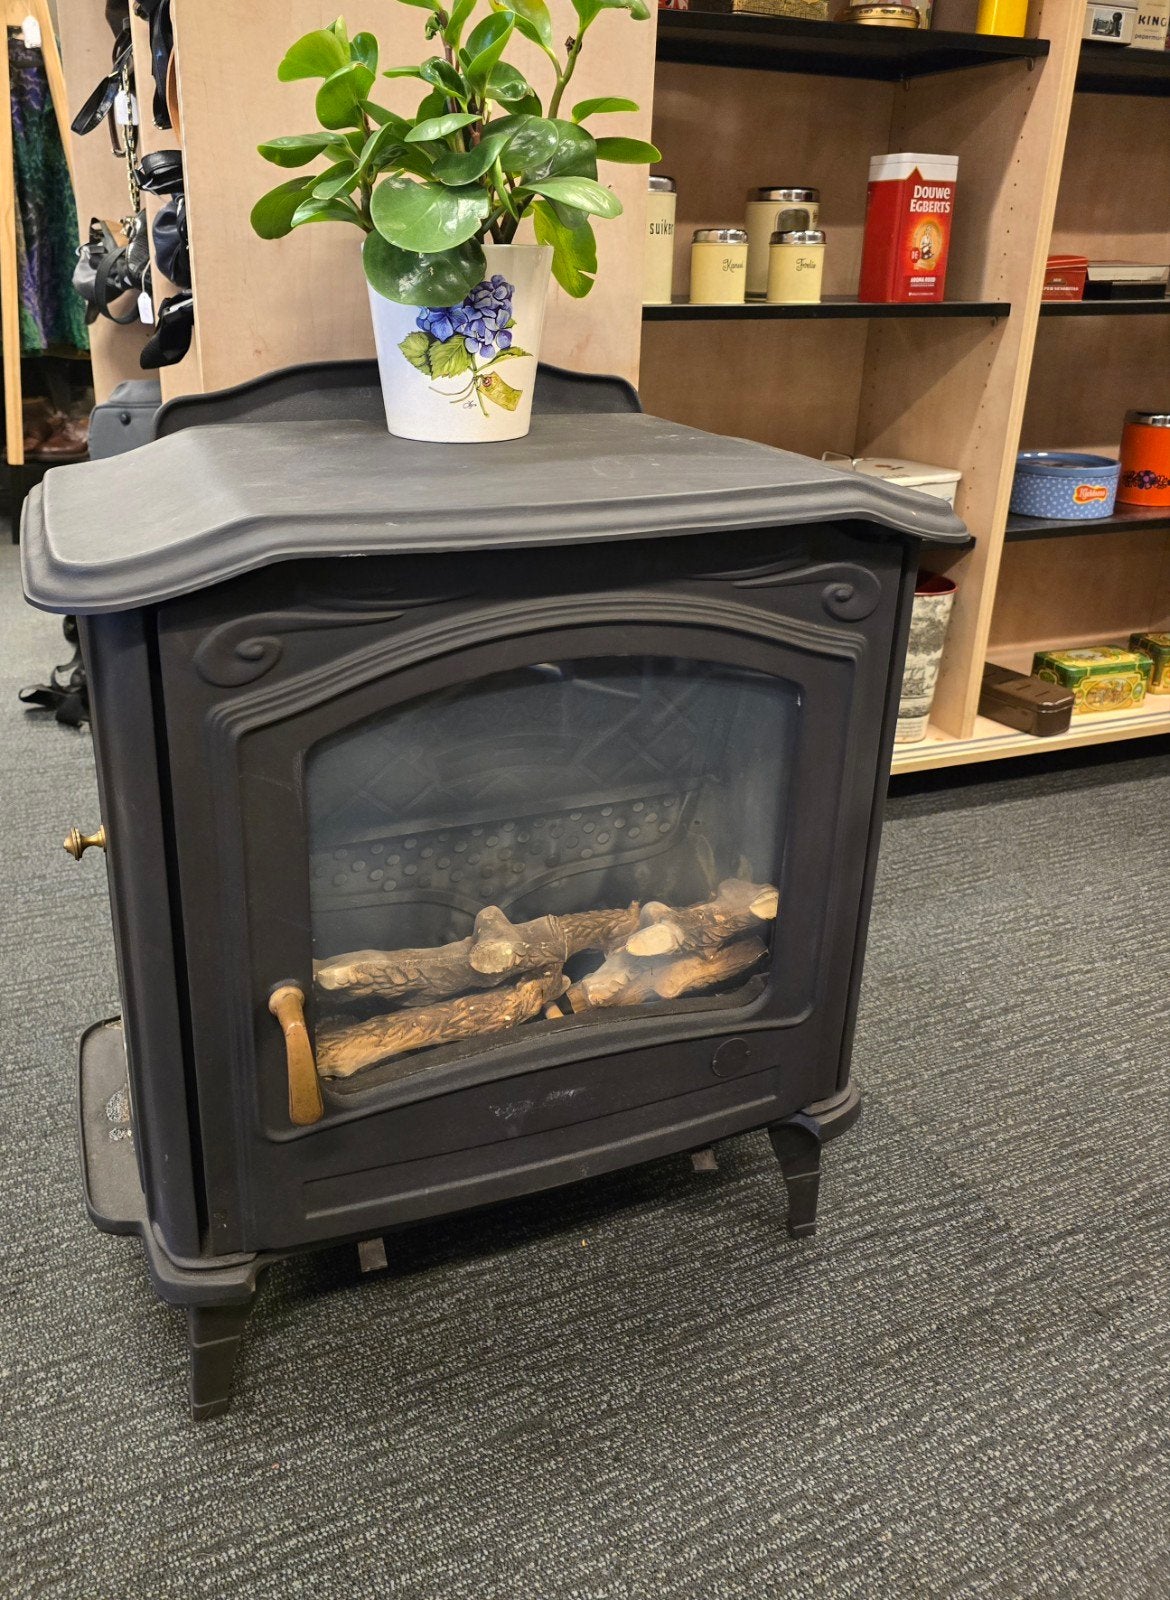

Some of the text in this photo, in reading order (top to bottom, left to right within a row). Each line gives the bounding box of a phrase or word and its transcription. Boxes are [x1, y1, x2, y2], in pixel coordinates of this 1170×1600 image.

[1138, 15, 1167, 27] KING
[909, 199, 951, 213] EGBERTS
[649, 219, 674, 235] suiker
